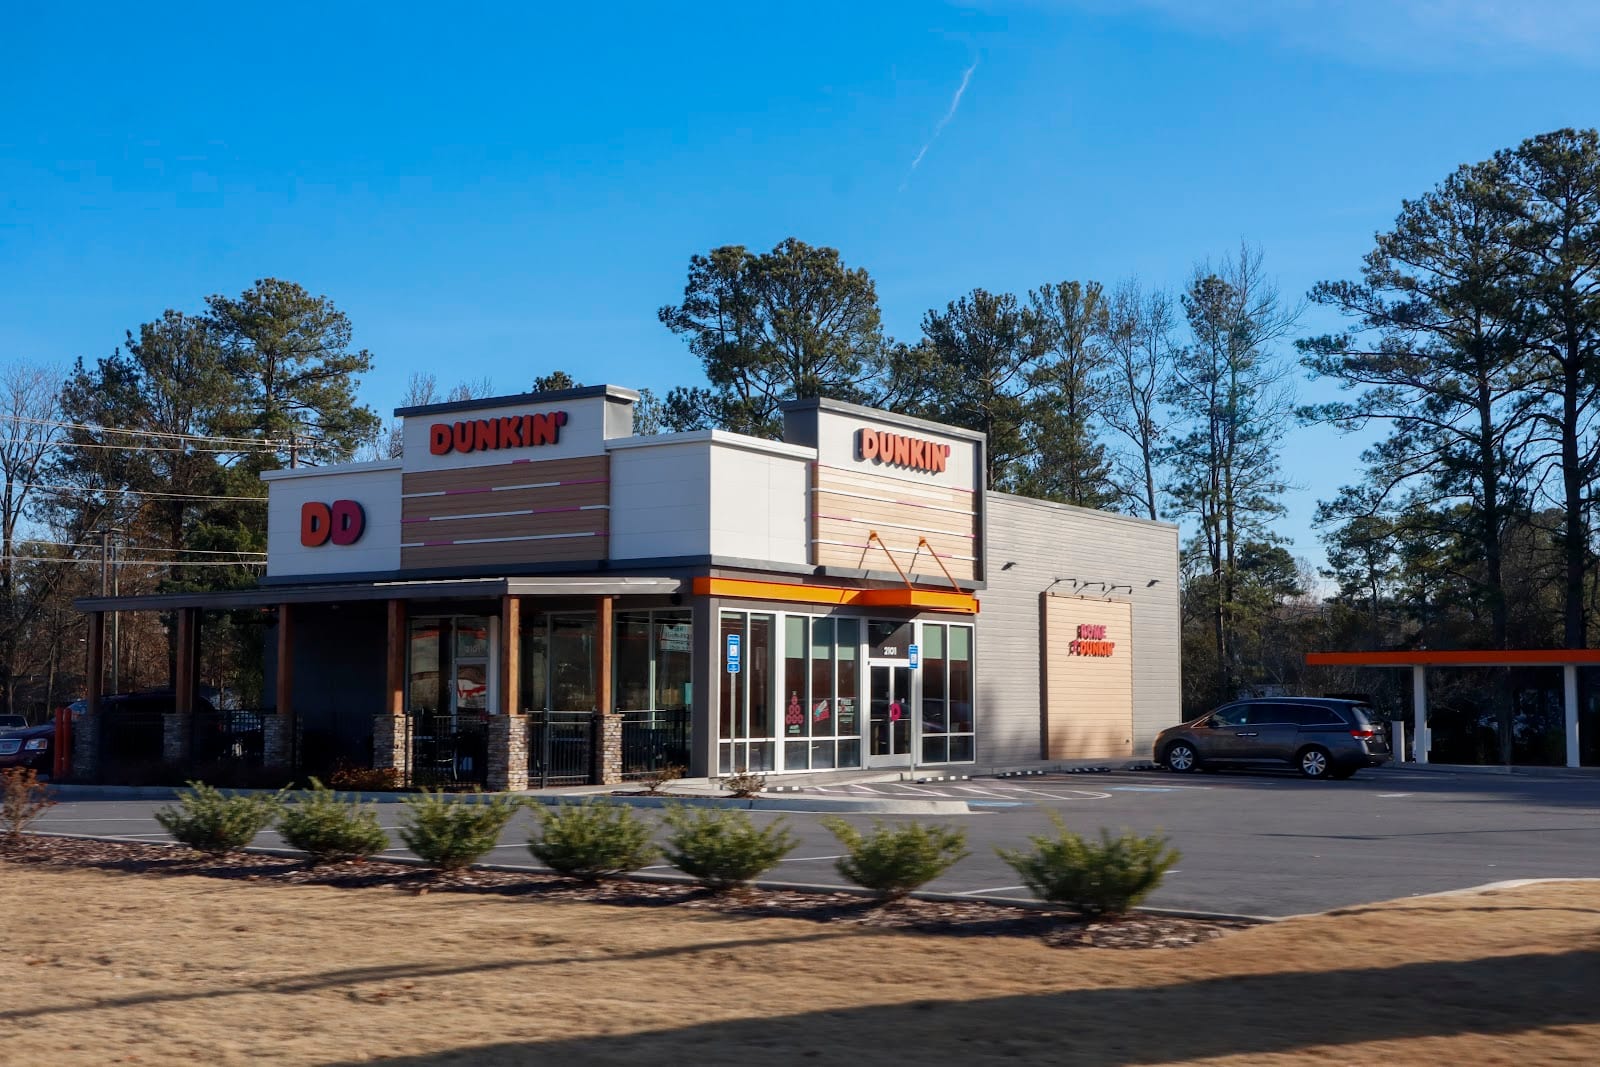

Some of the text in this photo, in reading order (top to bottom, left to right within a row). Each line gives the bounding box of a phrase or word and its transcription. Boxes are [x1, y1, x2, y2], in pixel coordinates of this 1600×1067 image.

[430, 411, 567, 455] DUNKIN'
[862, 428, 950, 472] DUNKIN'
[301, 500, 366, 547] DD
[884, 647, 897, 655] 2101
[1080, 641, 1115, 656] DUNKIN'
